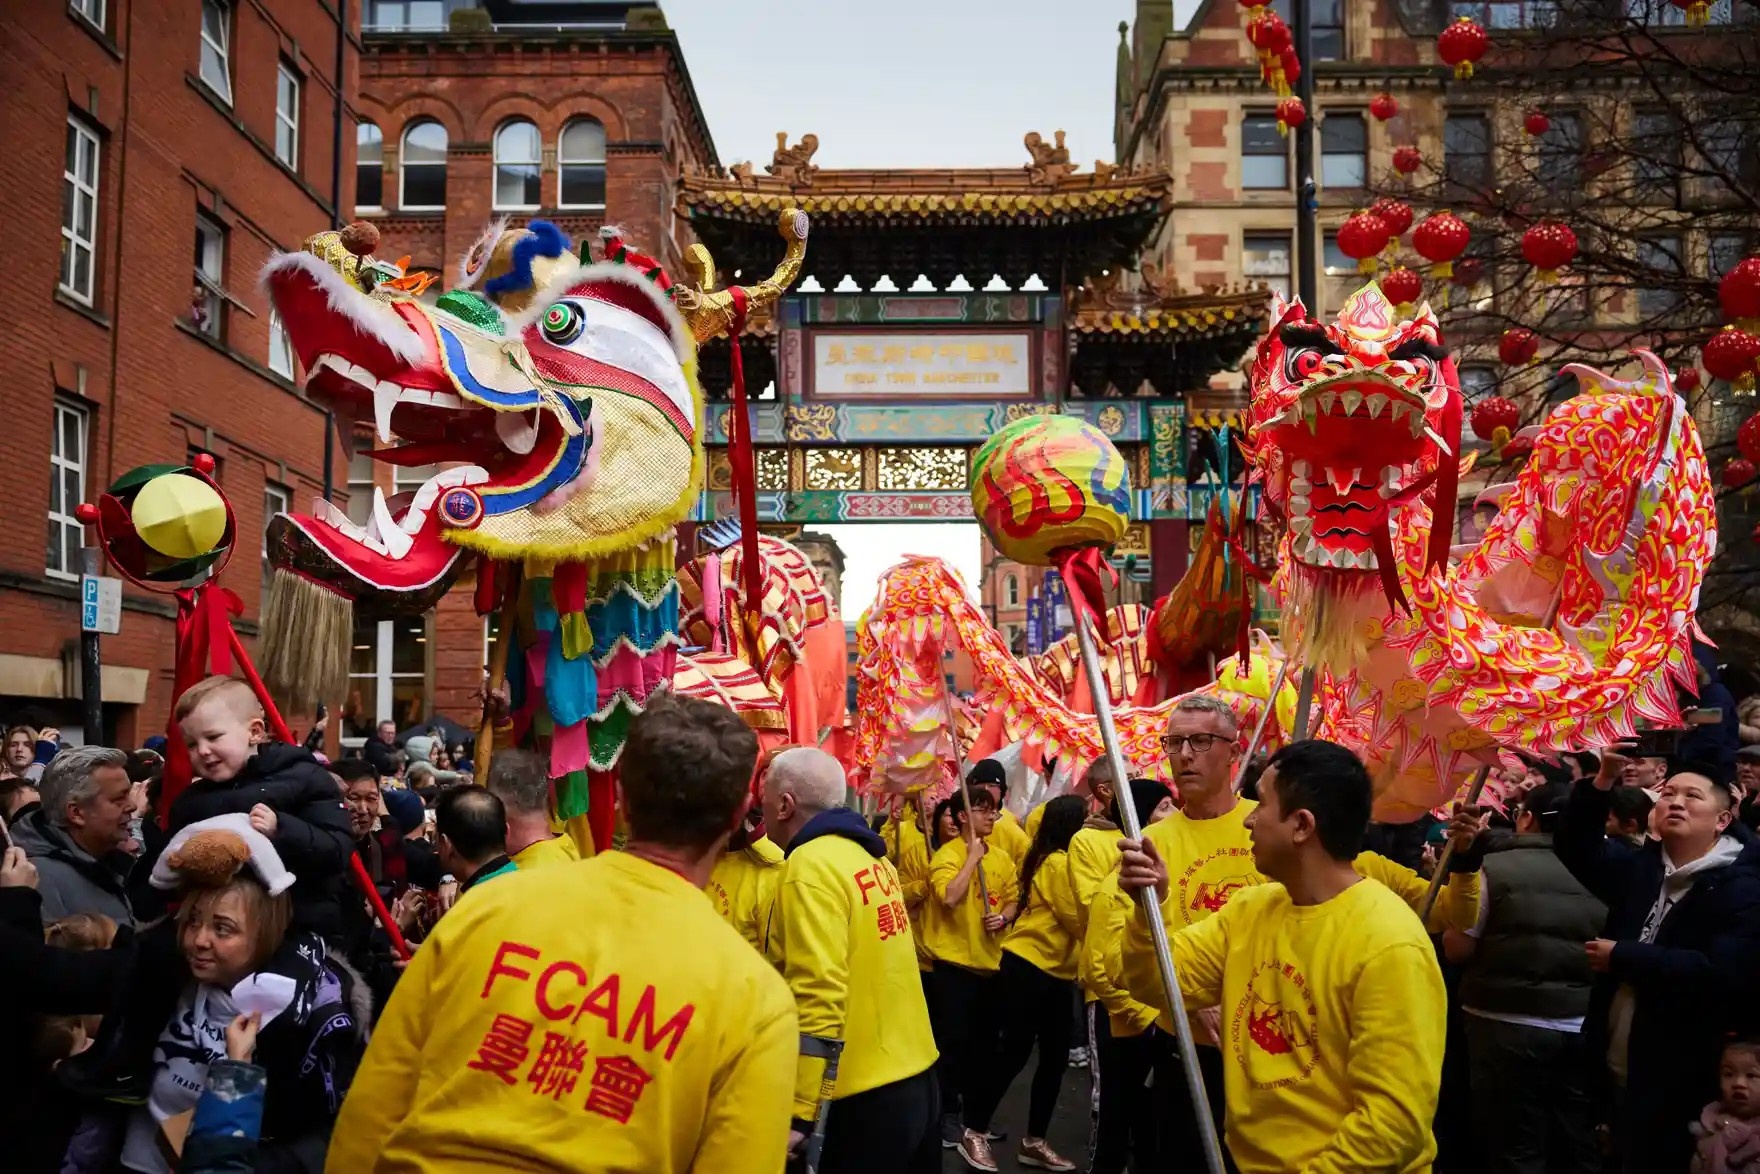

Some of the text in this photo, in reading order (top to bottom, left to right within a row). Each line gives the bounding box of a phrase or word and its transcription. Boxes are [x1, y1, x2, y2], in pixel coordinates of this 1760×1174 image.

[886, 372, 917, 385] TOWN
[87, 582, 96, 600] P
[479, 941, 696, 1062] FCAM
[467, 1013, 653, 1125] 曼聯會
[172, 1074, 202, 1092] TRADE
